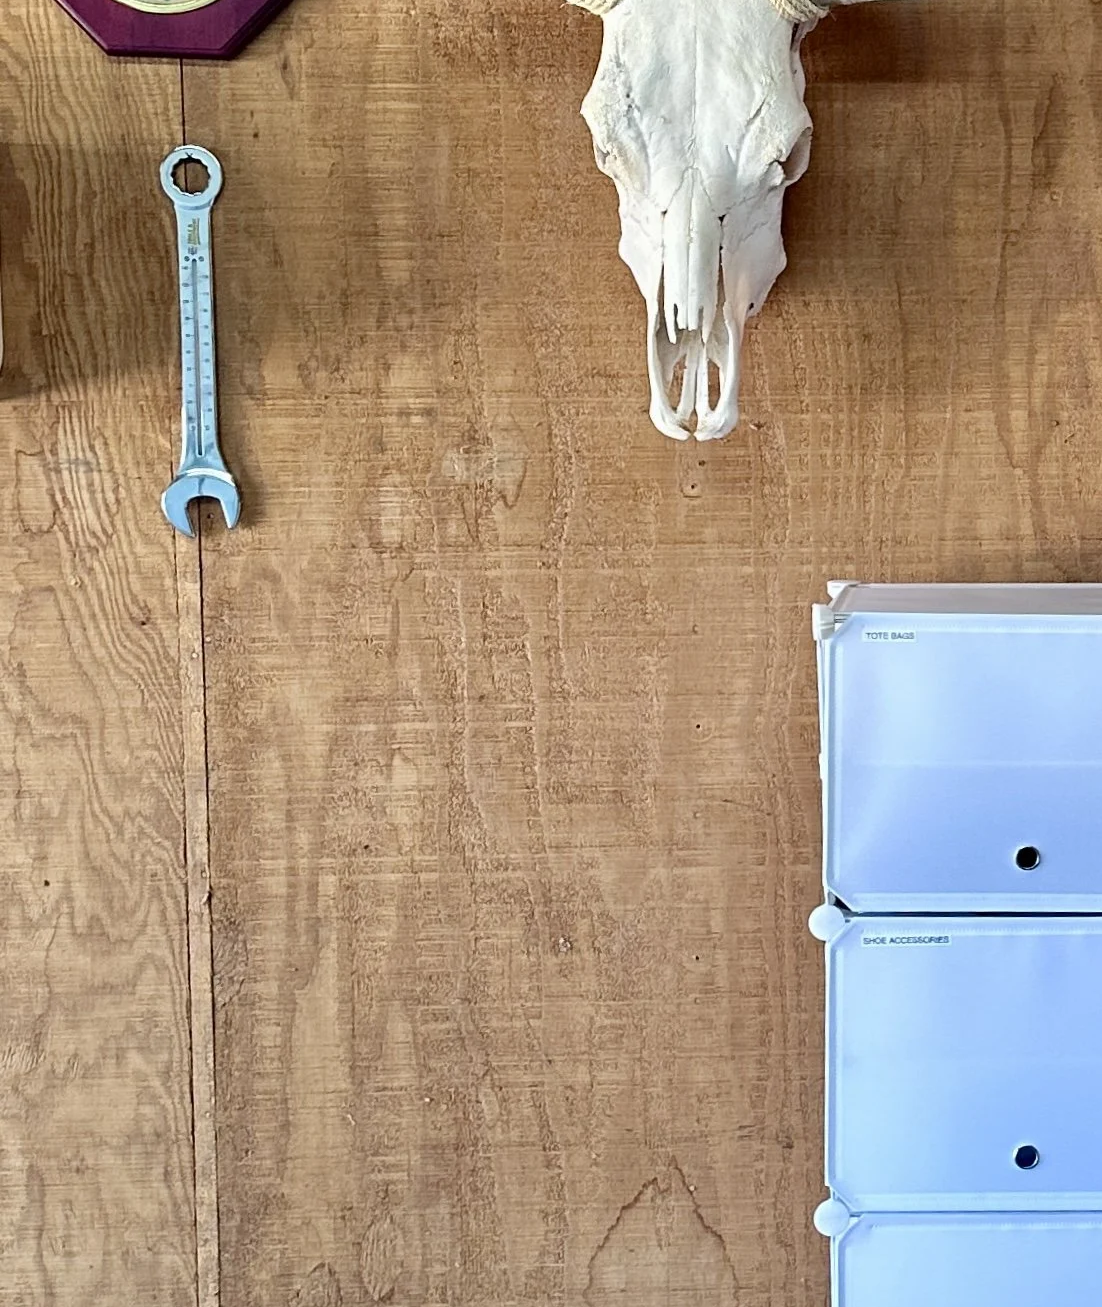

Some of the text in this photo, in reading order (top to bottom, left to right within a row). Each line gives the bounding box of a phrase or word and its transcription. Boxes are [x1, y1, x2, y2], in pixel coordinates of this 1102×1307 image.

[865, 632, 915, 640] TOTE BAGS
[863, 936, 949, 945] SHOE ACCESSORIES
